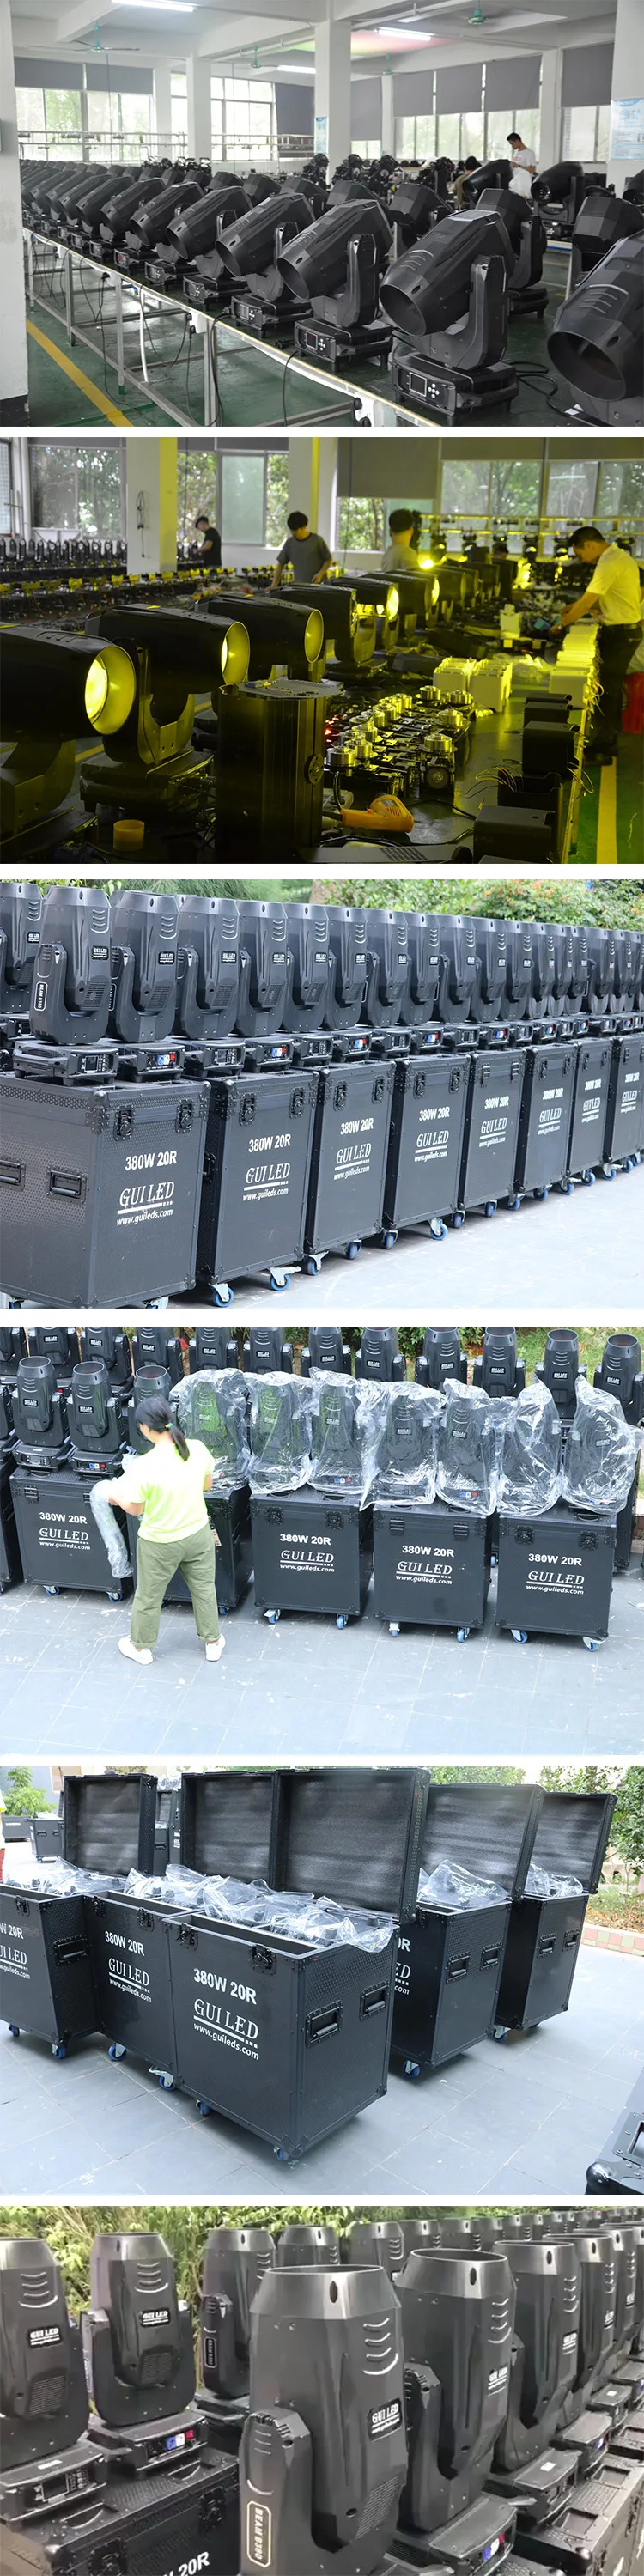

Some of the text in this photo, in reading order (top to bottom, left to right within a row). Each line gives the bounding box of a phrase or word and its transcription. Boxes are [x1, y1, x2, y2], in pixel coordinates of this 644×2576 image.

[419, 1106, 450, 1121] 380W 20R
[340, 1117, 374, 1135] 380W 20R
[481, 1117, 507, 1134] GUI LED
[248, 1133, 291, 1153] 380W 20R
[416, 1130, 449, 1148] GUI LED
[125, 1151, 177, 1171] 380W 20R
[336, 1143, 372, 1164] GUI LED
[246, 1163, 291, 1184] GUI LED
[119, 1181, 175, 1207] GUI LED
[242, 1188, 289, 1201] www.guileds.com
[116, 1209, 173, 1226] www.guileds.com
[39, 1512, 88, 1524] 380W 20R
[39, 1528, 89, 1541] GUI LED
[279, 1533, 331, 1546] 380W 20R
[39, 1541, 91, 1551] www.guileds.com
[402, 1545, 455, 1558] 380W 20R
[281, 1549, 334, 1564] GUI LED
[528, 1553, 583, 1566] 380W 20R
[280, 1564, 335, 1573] www.guileds.com
[397, 1561, 453, 1576] GUI LED
[395, 1575, 453, 1585] www.guileds.com
[527, 1571, 585, 1585] GUI LED
[526, 1585, 584, 1595] www.guileds.com
[8, 1924, 24, 1940] 20R
[104, 1930, 145, 1957] 380W 20R
[8, 1947, 27, 1965] LED
[108, 1958, 150, 1986] GUI LED
[109, 1978, 152, 2003] www.guileds.com
[193, 1967, 257, 2005] 380W 20R
[194, 1998, 259, 2039] GUI LED
[193, 2023, 259, 2061] www.guileds.com
[386, 2403, 399, 2418] LED
[254, 2507, 264, 2536] BEAM
